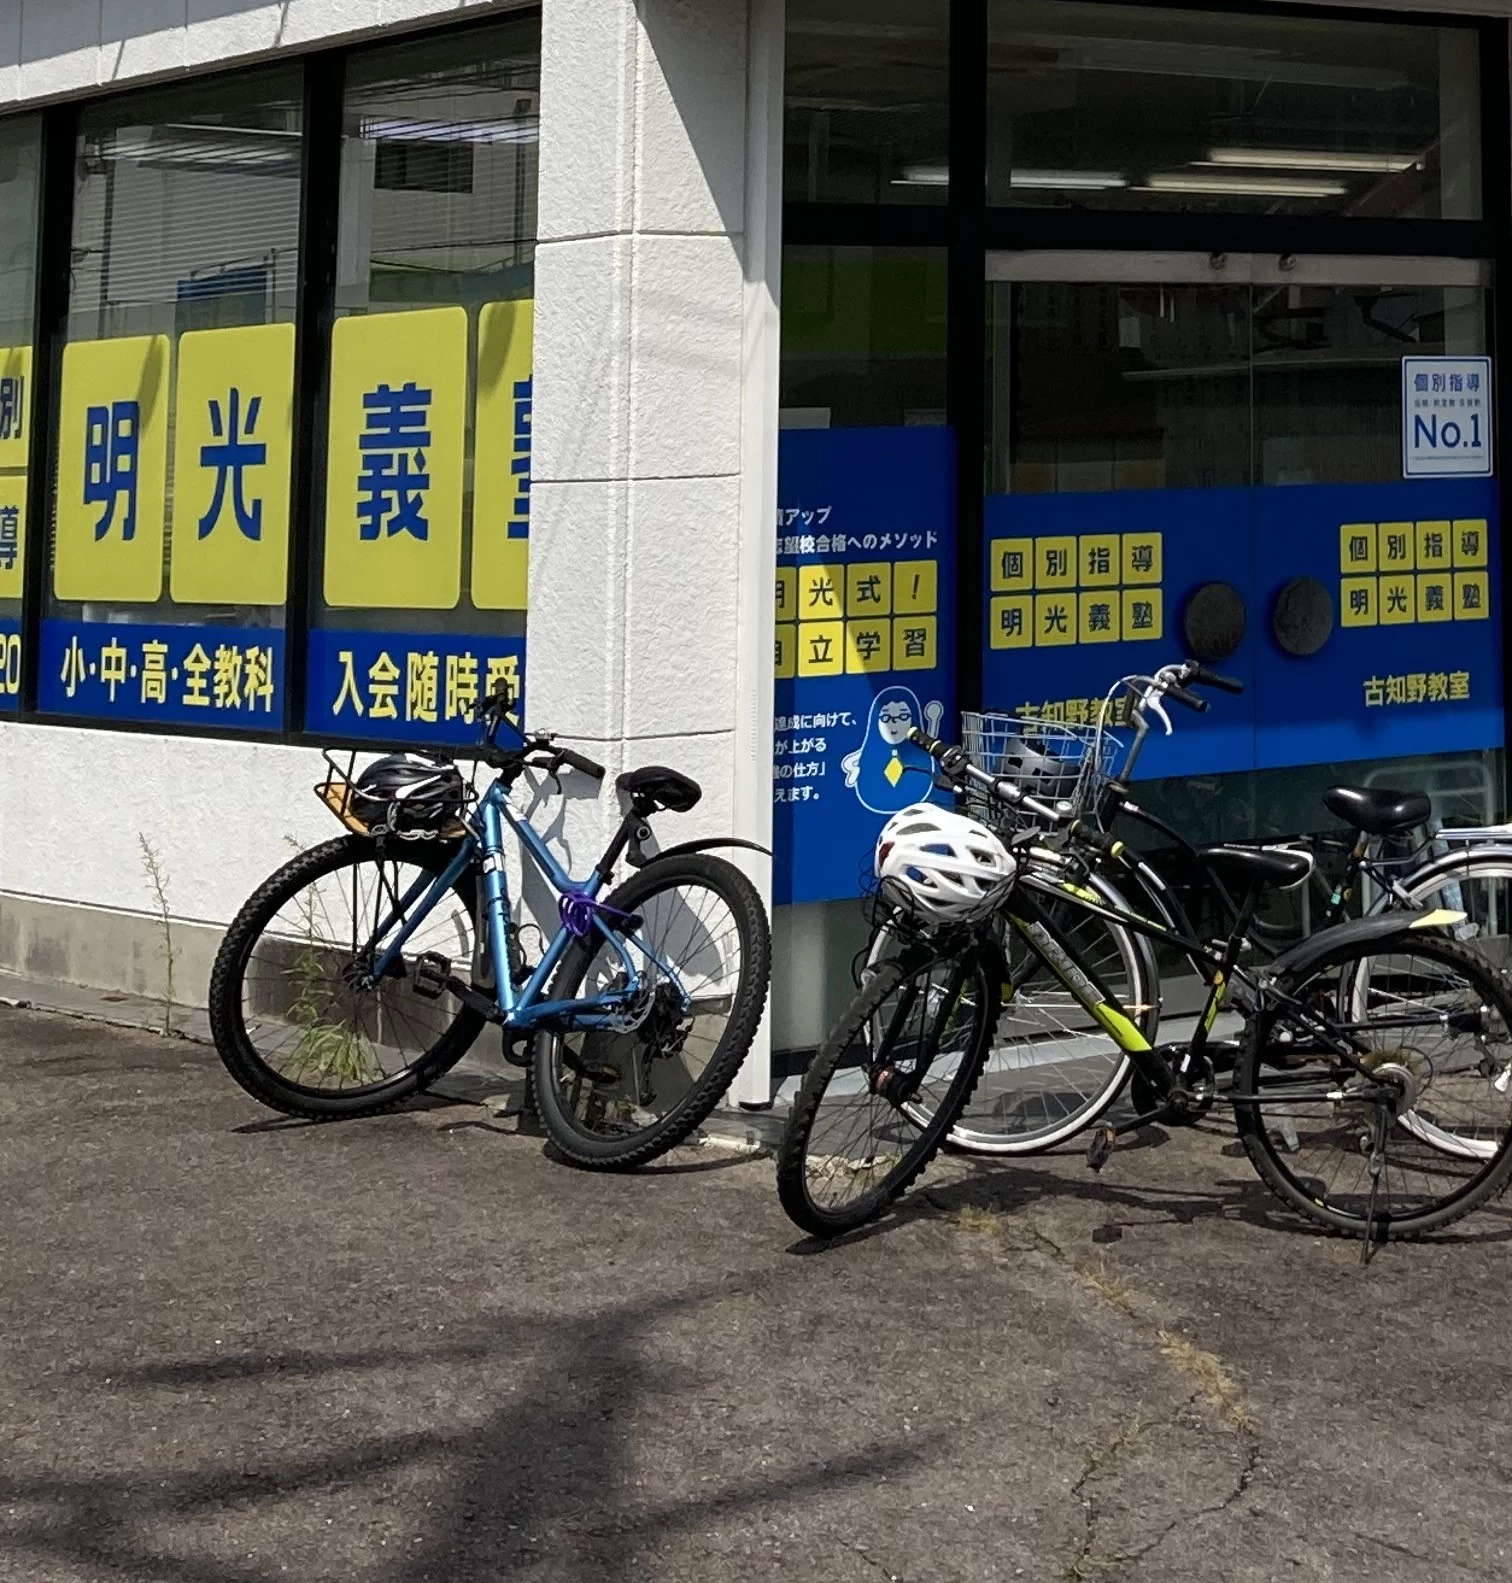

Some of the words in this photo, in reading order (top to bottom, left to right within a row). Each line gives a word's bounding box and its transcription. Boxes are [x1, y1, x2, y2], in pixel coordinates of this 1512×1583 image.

[1414, 373, 1480, 393] 個別指導
[1414, 413, 1482, 449] No.1
[1001, 545, 1153, 579] 個別指導
[1348, 529, 1480, 561] 個別指導
[1349, 582, 1481, 617] 明光義塾
[1001, 600, 1153, 638] 明光義塾
[60, 635, 275, 714] 小・中・高・全教科
[1362, 669, 1471, 708] 古知野教室
